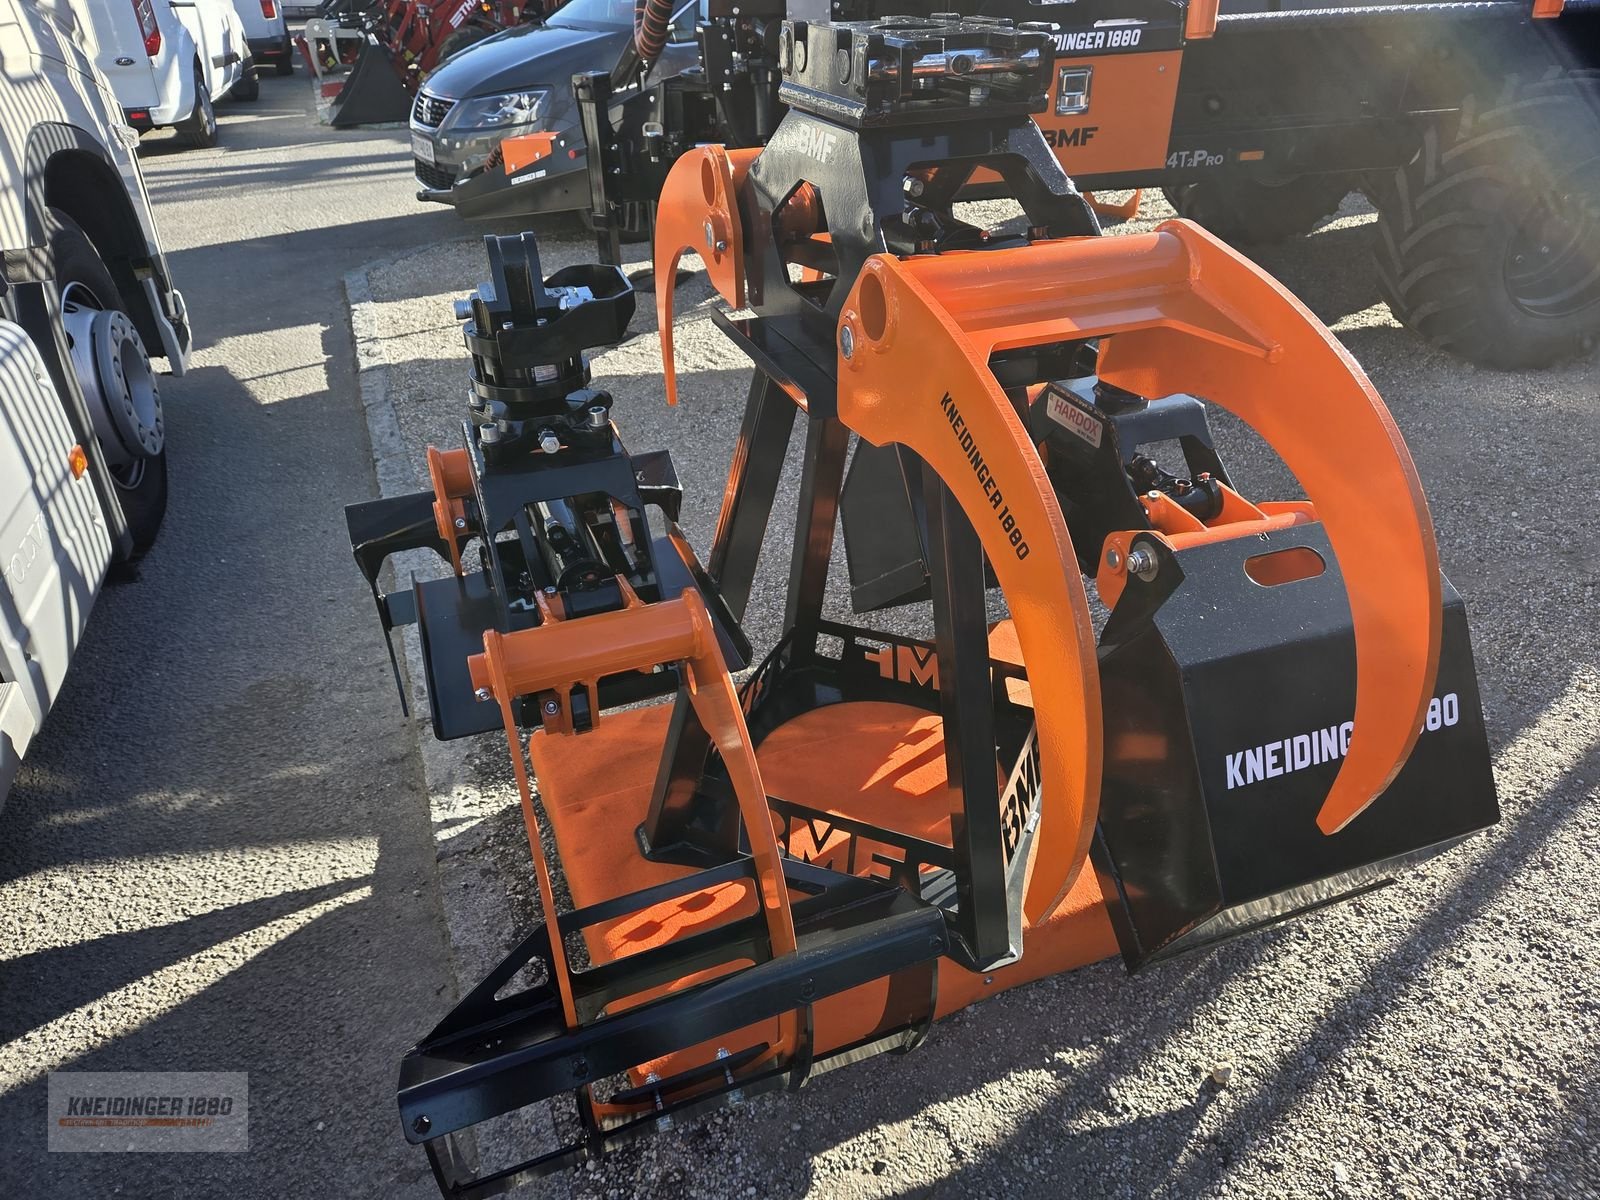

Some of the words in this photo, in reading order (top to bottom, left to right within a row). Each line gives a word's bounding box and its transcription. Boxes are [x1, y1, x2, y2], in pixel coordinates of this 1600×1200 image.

[1107, 29, 1142, 47] 1880
[797, 123, 837, 163] BMF
[1042, 127, 1098, 148] BMF
[1054, 399, 1099, 437] HARDOX
[940, 391, 1003, 510] KNEIDINGER
[998, 505, 1030, 561] 1880
[1420, 693, 1459, 735] 80
